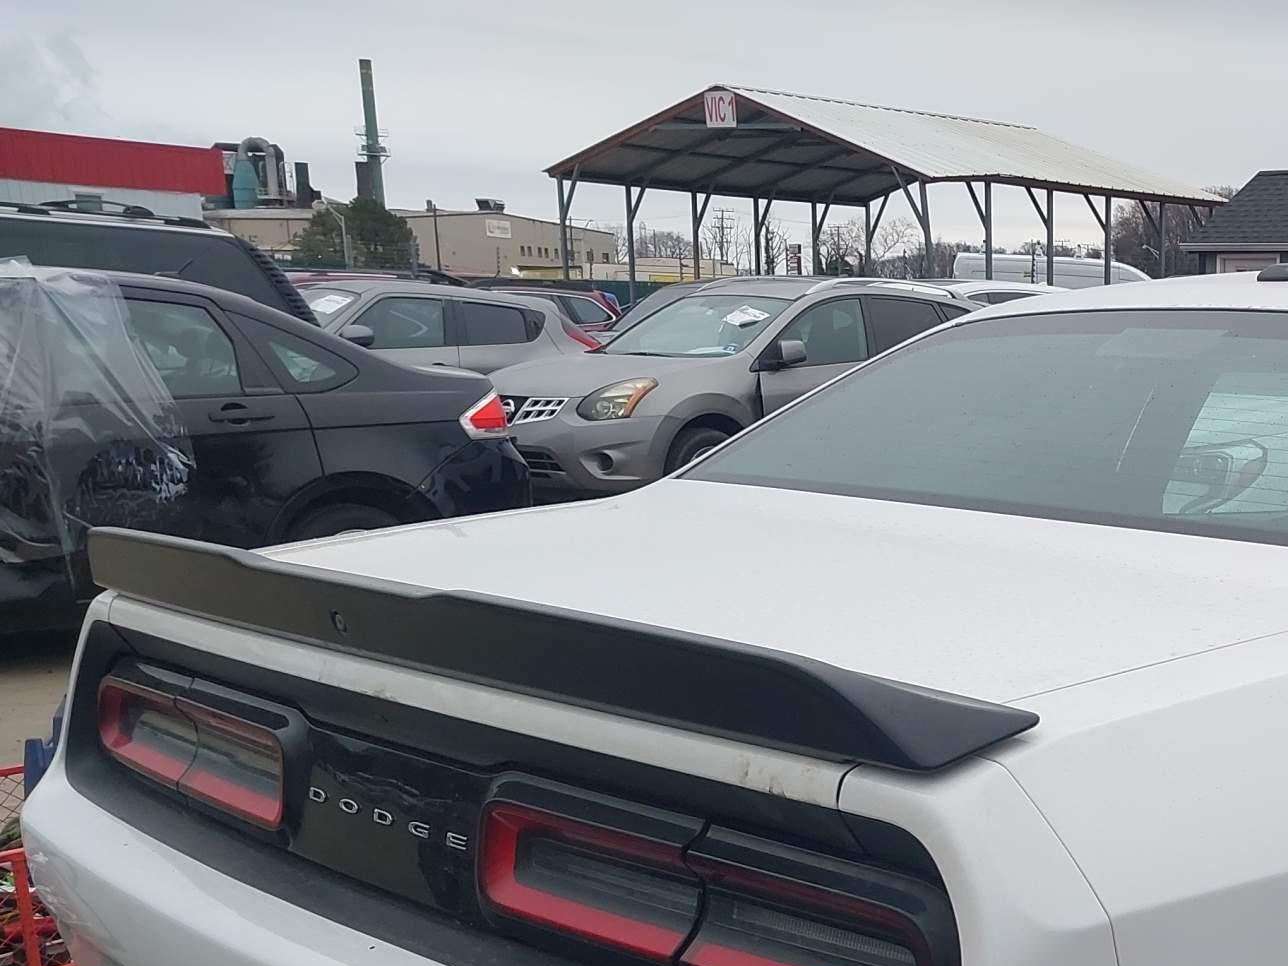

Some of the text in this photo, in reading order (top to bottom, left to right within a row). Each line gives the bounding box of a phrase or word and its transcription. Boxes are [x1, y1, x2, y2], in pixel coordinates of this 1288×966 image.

[706, 95, 735, 122] VIC 1
[309, 787, 468, 850] DODGE
